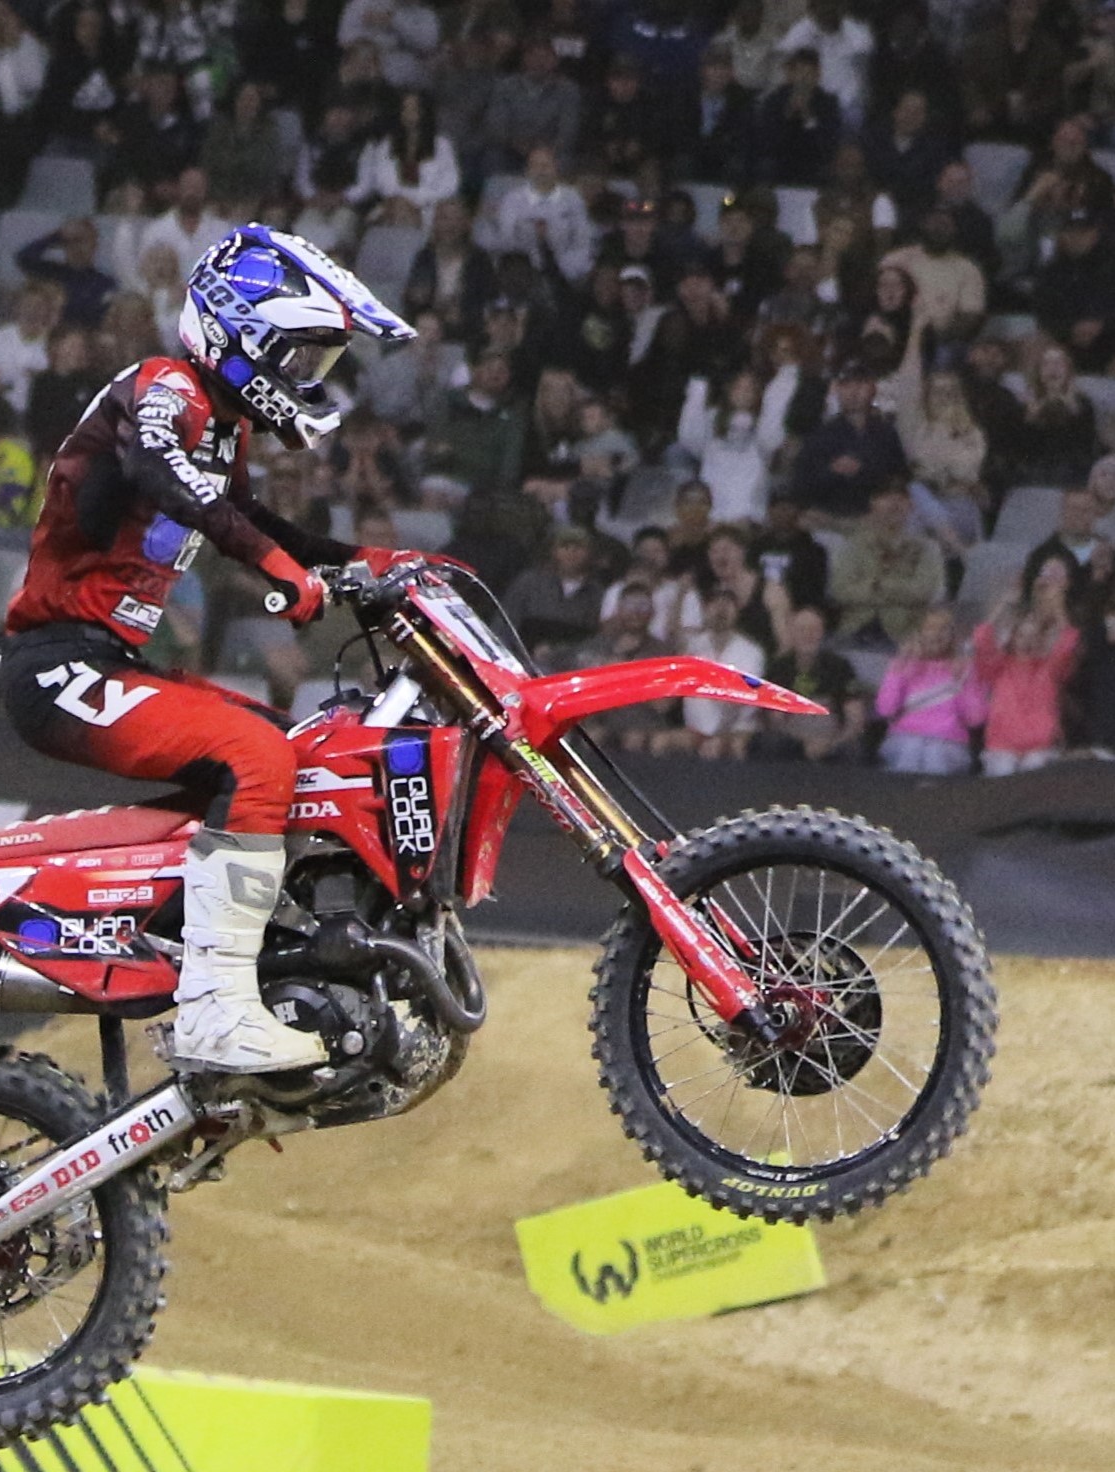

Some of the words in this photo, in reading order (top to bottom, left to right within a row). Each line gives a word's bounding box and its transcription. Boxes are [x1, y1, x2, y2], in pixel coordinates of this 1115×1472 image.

[193, 270, 266, 335] 00%
[241, 384, 286, 427] LOCK
[251, 376, 298, 418] QUAD
[296, 772, 319, 784] RC
[390, 778, 417, 854] LOCK
[408, 776, 435, 852] QUAD
[61, 937, 134, 955] LOCK
[107, 1106, 175, 1154] froth
[721, 1178, 820, 1198] DUNLOP
